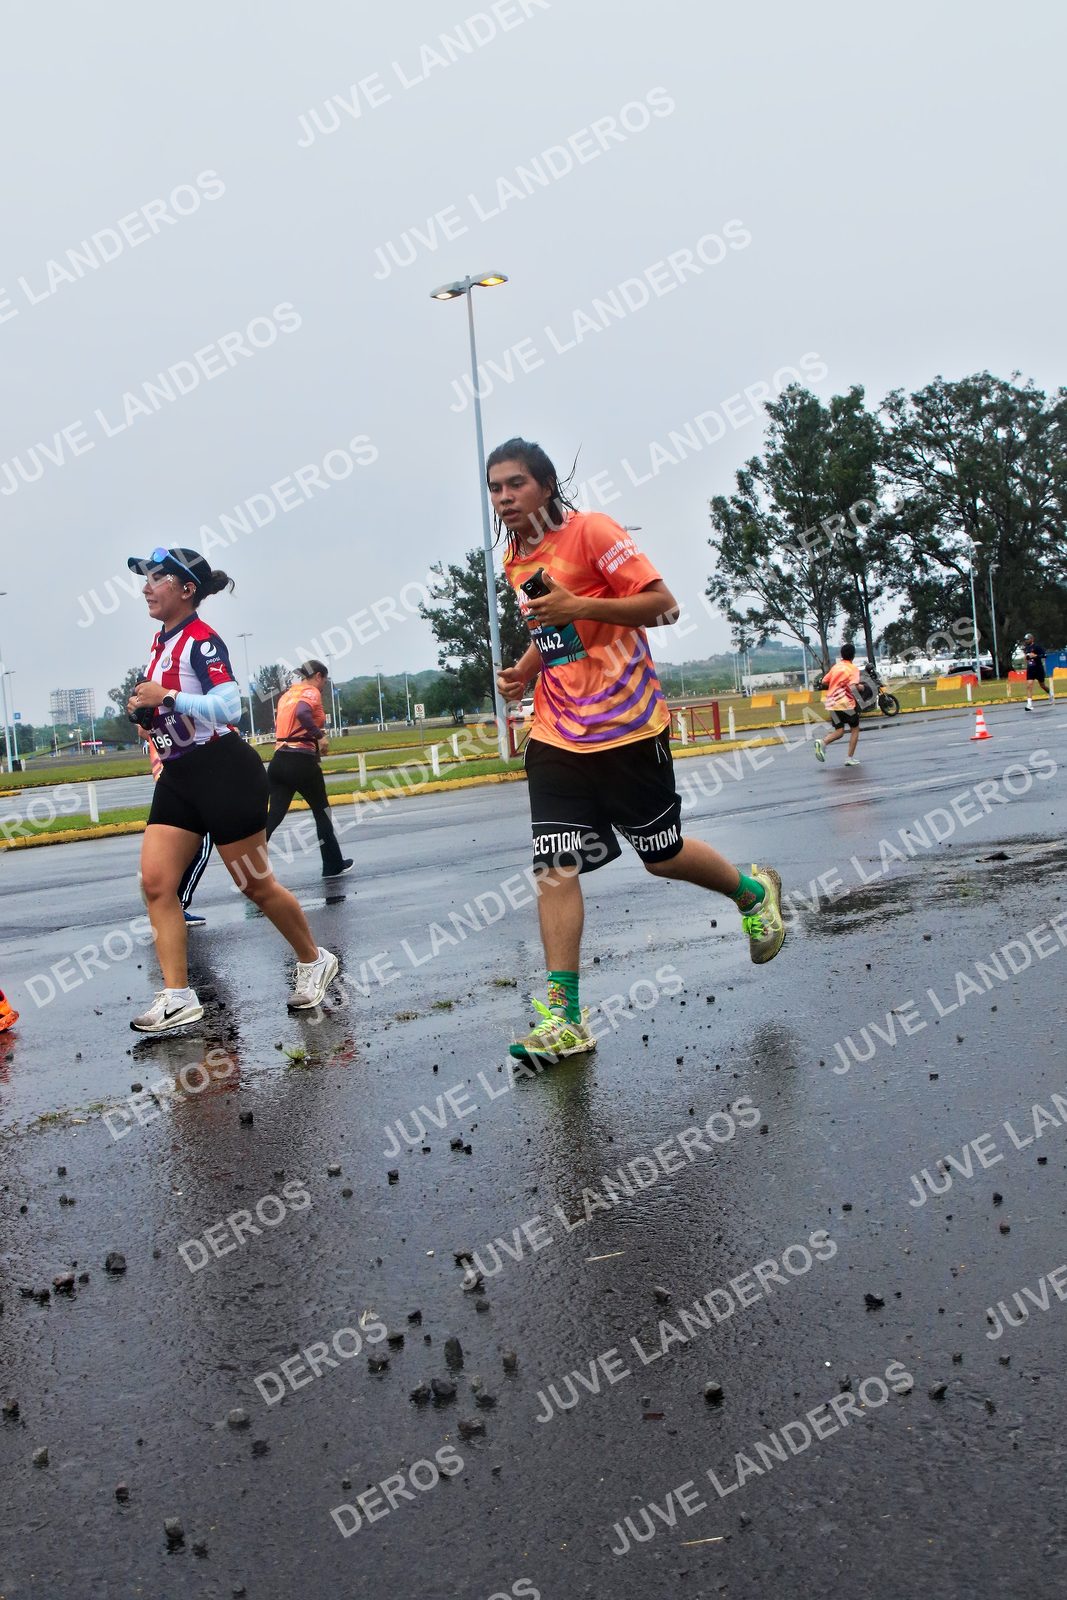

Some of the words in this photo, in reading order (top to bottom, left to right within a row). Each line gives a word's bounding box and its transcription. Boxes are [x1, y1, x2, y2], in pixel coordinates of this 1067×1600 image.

[536, 632, 564, 654] 1442
[151, 733, 173, 750] 196
[629, 824, 679, 853] ECTIOM
